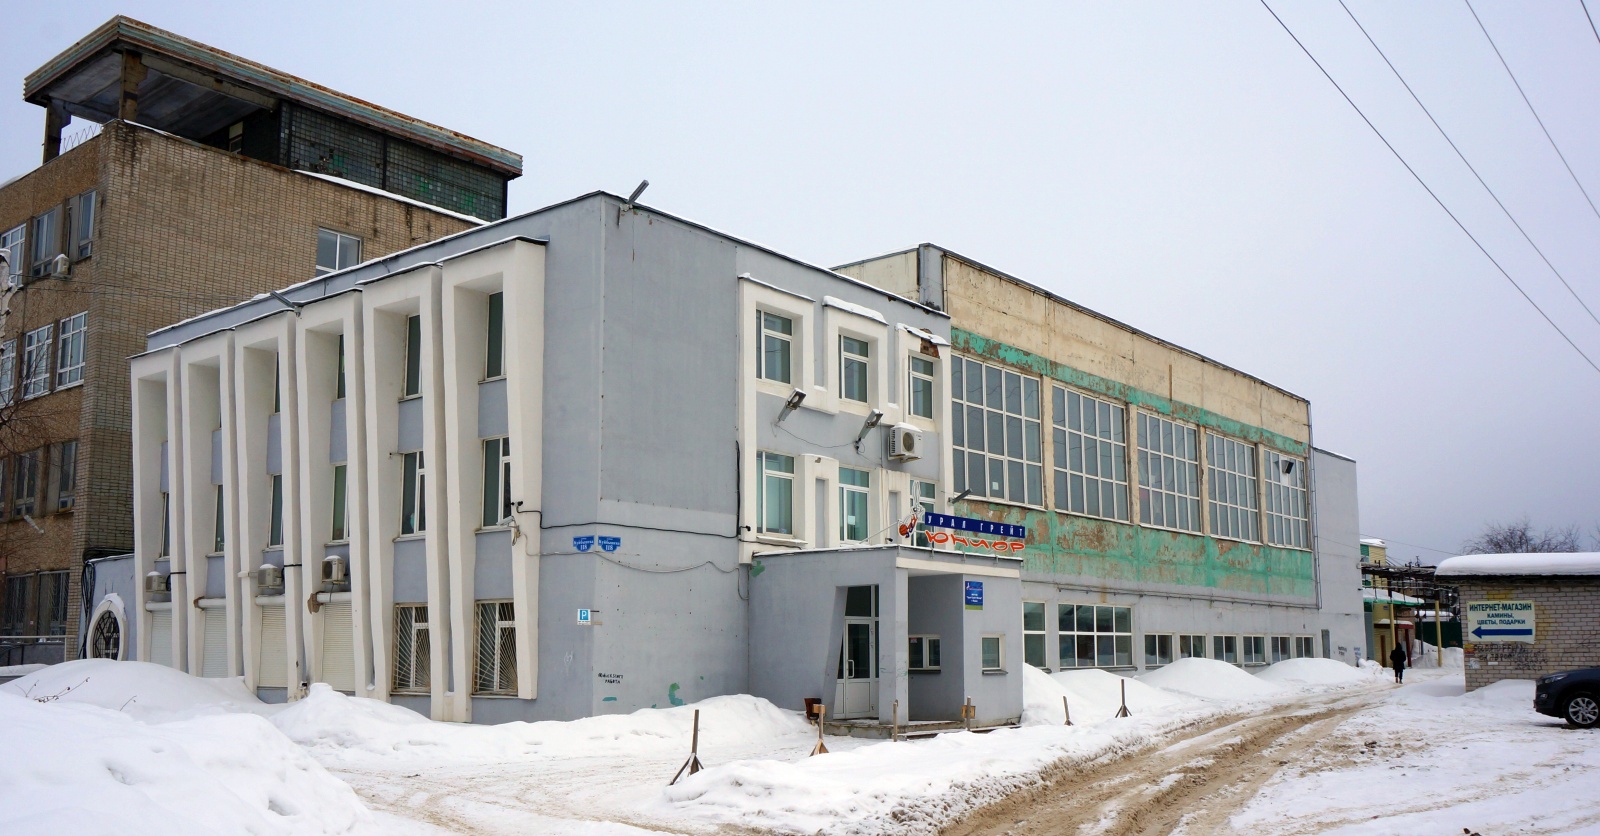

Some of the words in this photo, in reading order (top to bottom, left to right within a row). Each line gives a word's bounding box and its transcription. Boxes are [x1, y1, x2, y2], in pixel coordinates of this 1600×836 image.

[927, 515, 966, 529] УРАЛ
[980, 522, 1023, 537] ГРЕЙТ
[1469, 603, 1532, 612] ИНТЕРНЕТ-МАГАЗИН
[581, 610, 587, 620] P
